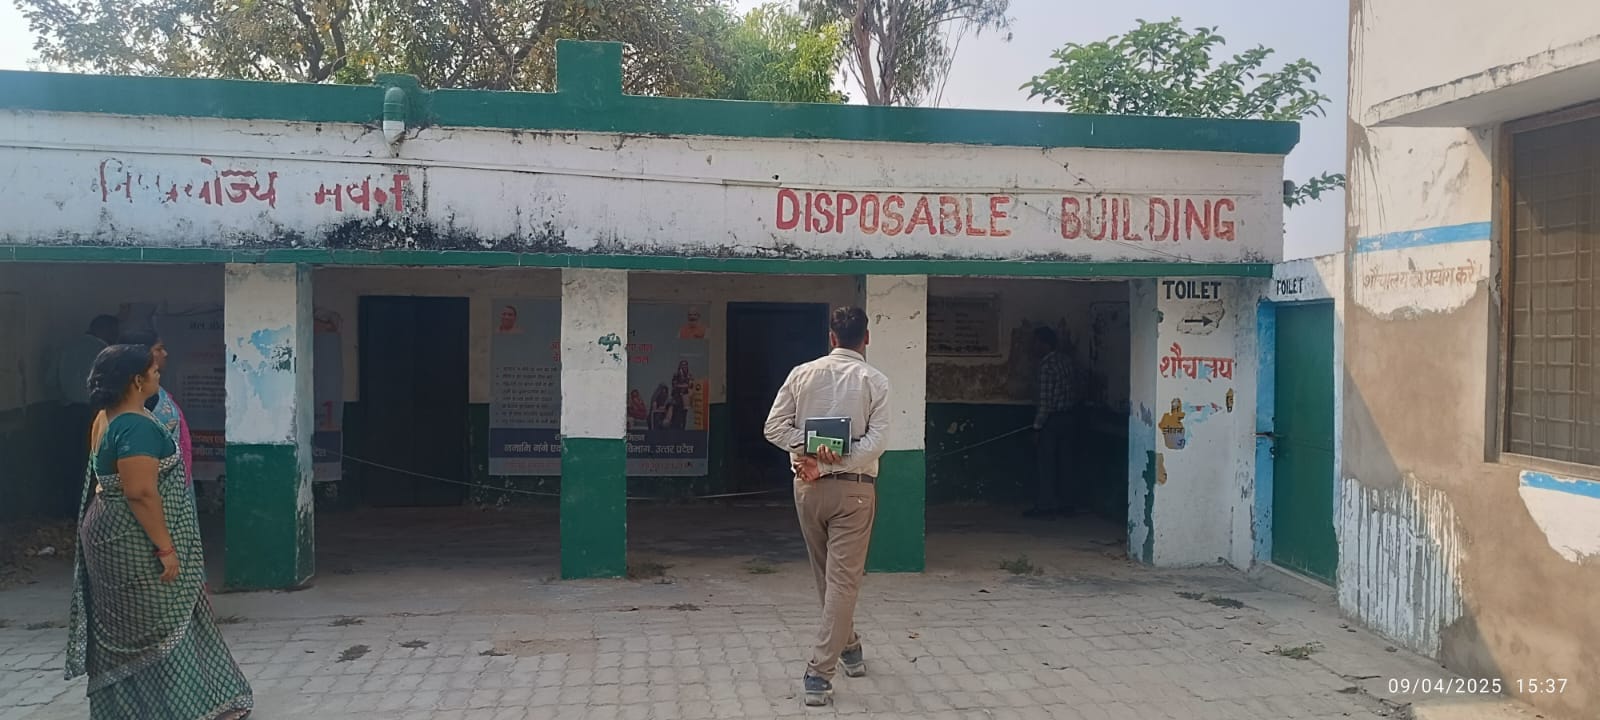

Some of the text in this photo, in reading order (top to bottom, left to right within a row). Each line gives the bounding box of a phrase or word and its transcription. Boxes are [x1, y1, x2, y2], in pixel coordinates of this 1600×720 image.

[776, 189, 1236, 242] DISPOSABLE BUILDING
[1163, 280, 1222, 300] TOILET
[1277, 277, 1303, 295] TOILET
[1160, 342, 1233, 383] शौचलय
